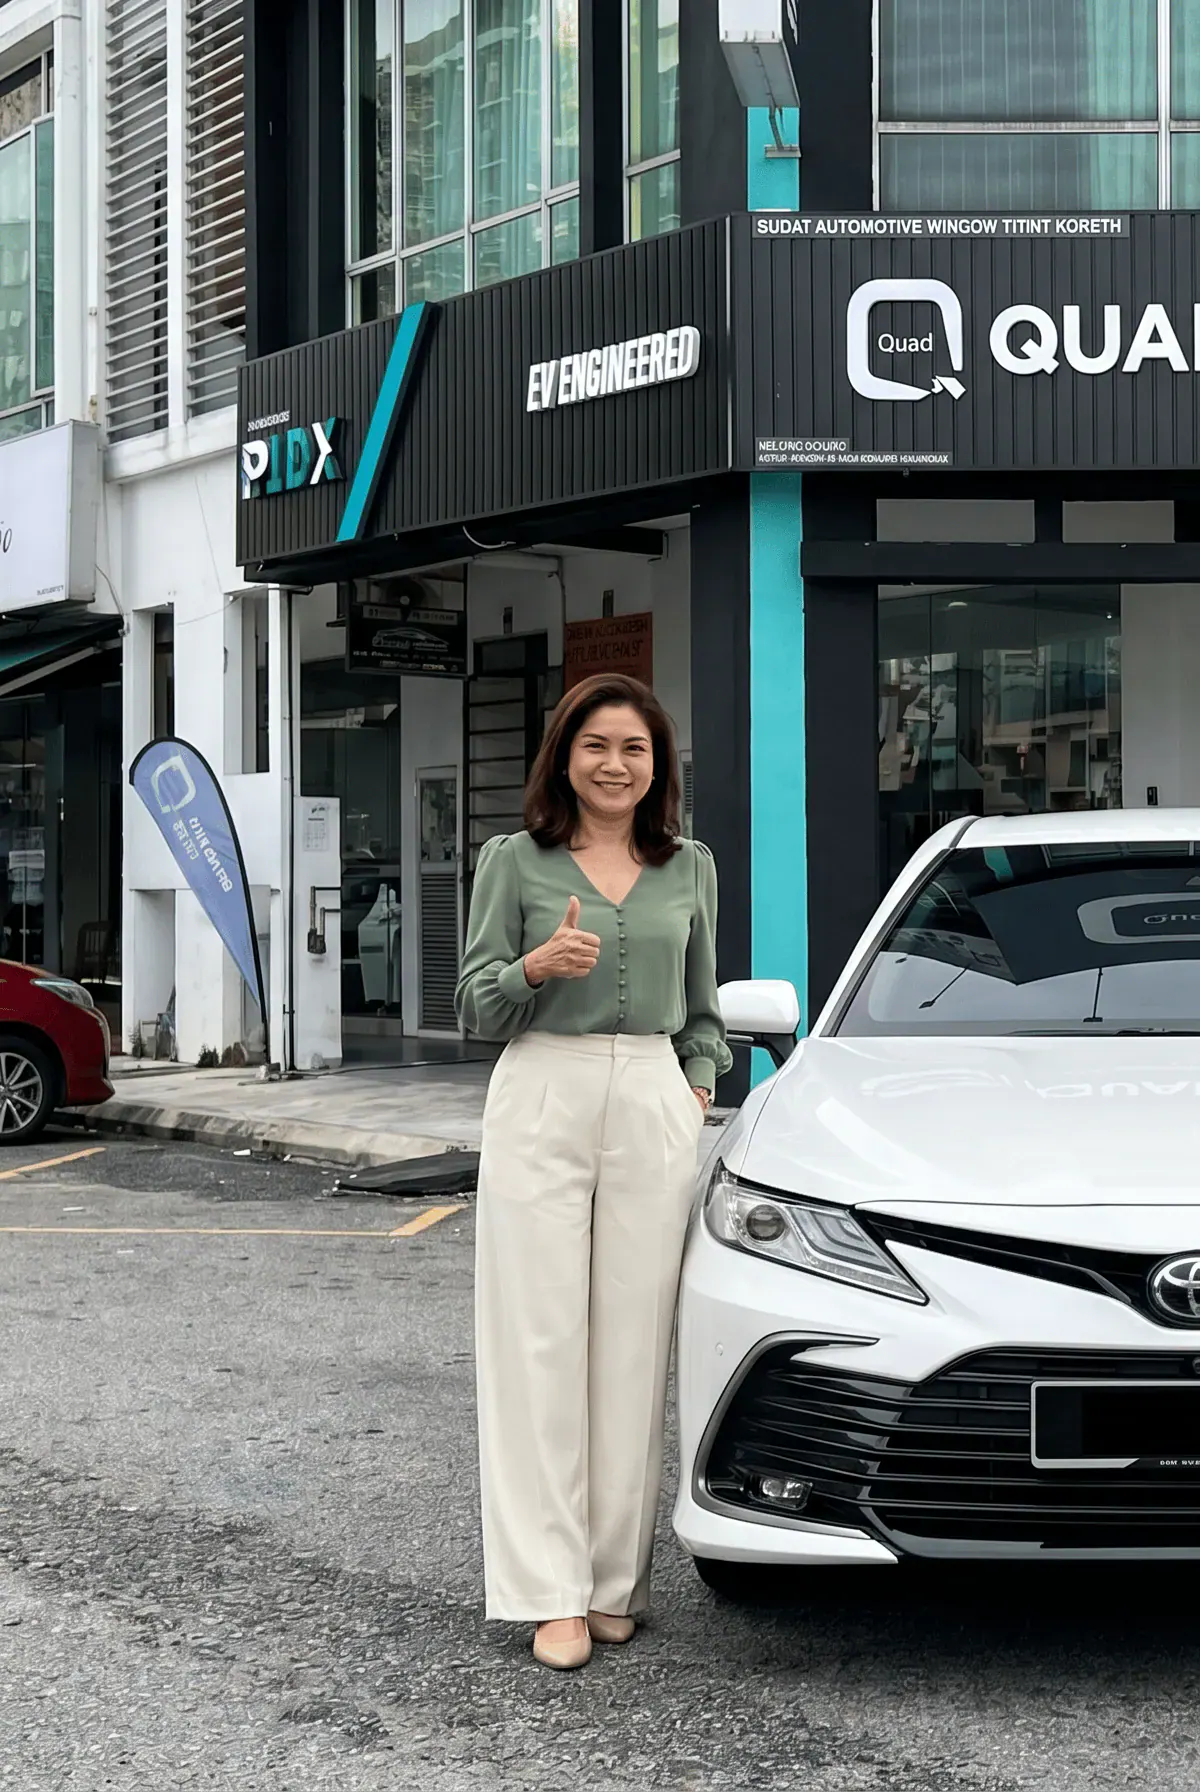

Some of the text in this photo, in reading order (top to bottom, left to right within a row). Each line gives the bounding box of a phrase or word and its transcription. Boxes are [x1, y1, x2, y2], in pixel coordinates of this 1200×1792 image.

[757, 218, 1122, 235] SUDAT AUTOMOTIVE WINGOW TITINT KORETH
[526, 325, 701, 412] EV ENGINEERED
[877, 333, 933, 355] Quad
[241, 416, 341, 500] PIDX
